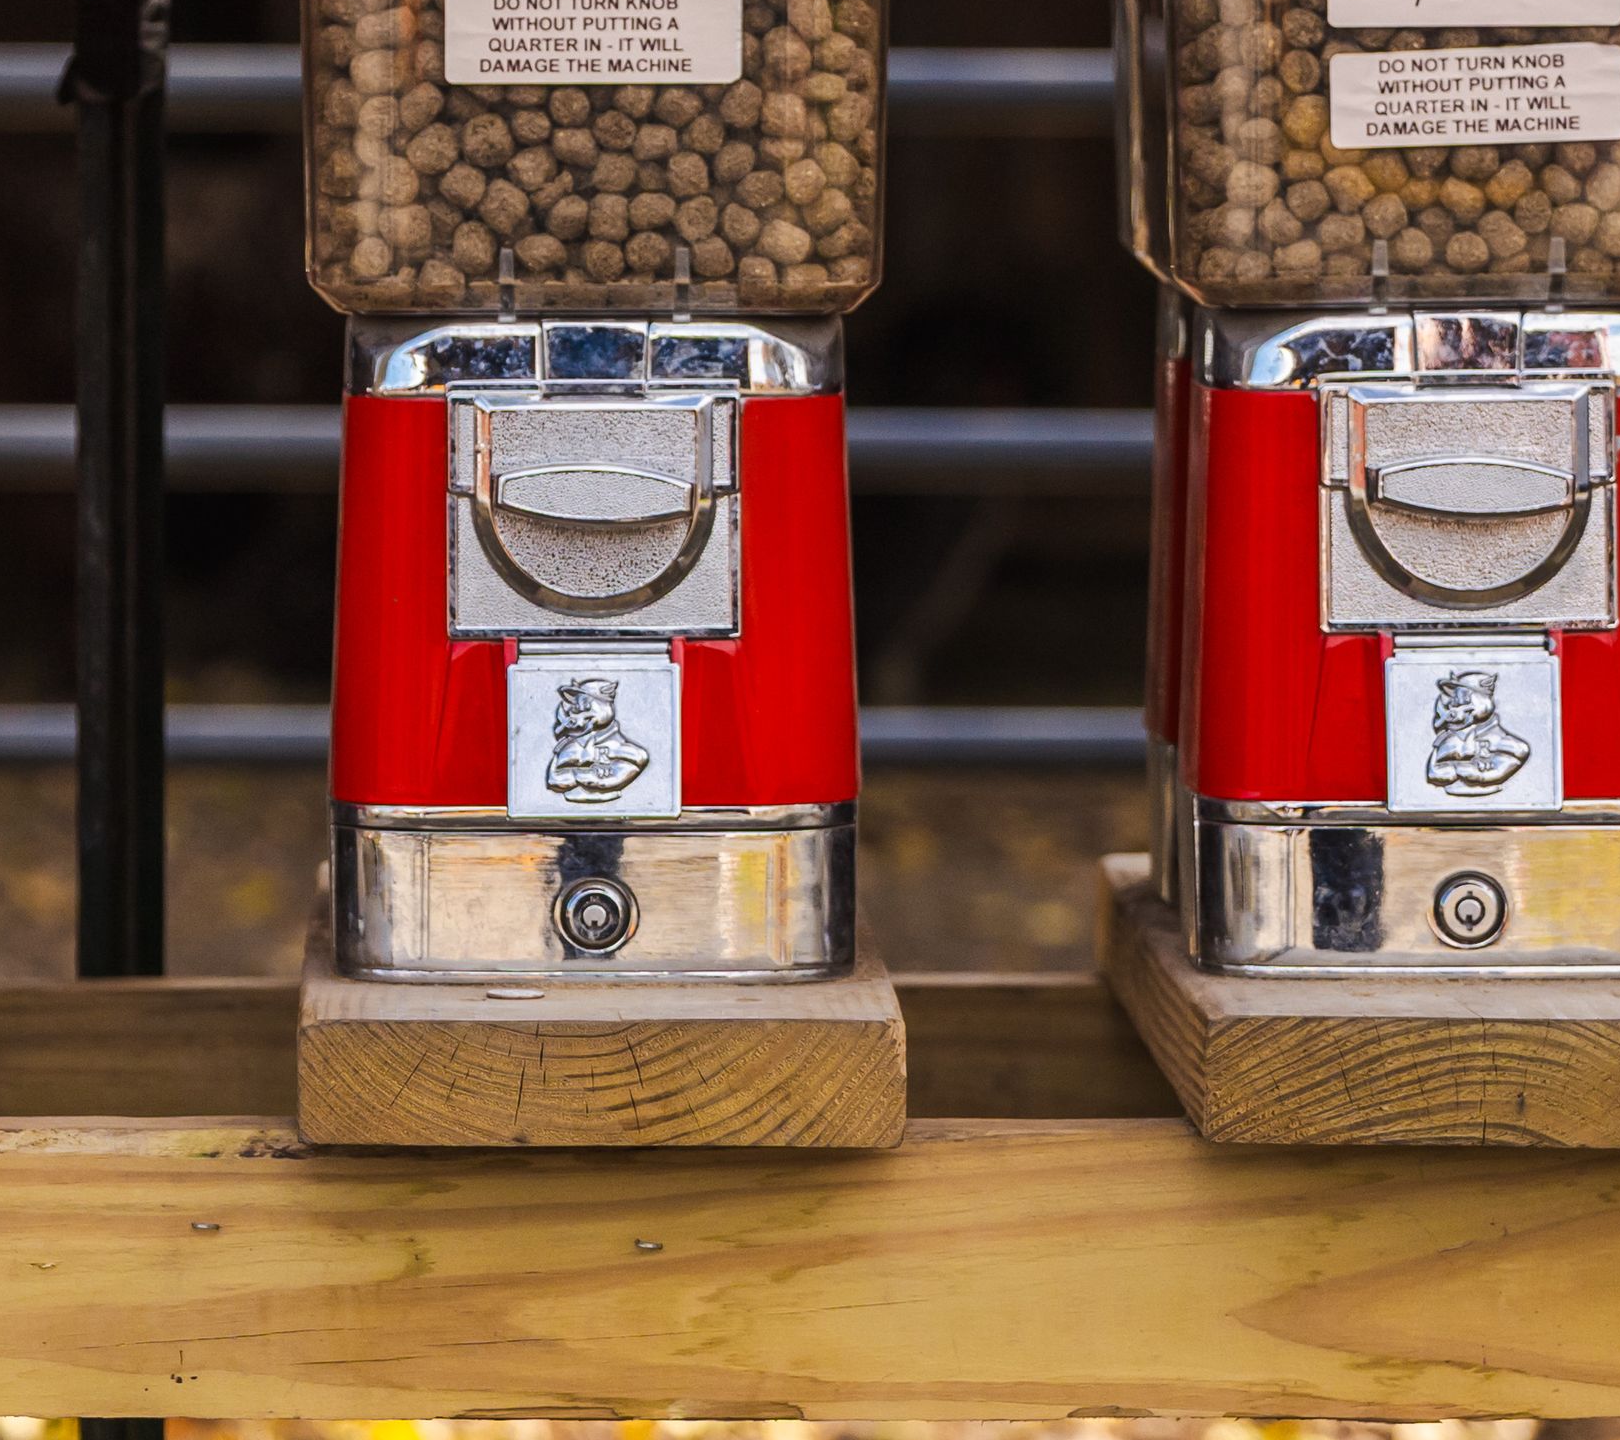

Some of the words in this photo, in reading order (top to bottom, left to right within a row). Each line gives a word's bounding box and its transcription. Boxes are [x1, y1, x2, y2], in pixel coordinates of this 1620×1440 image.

[491, 16, 577, 32] WITHOUT
[582, 16, 663, 32] PUTTING
[666, 16, 680, 31] A
[488, 37, 578, 54] QUARTER
[584, 37, 602, 52] IN
[618, 37, 635, 52] IT
[638, 37, 684, 52] WILL
[479, 58, 560, 73] DAMAGE
[565, 58, 602, 73] THE
[607, 58, 692, 73] MACHINE
[1378, 58, 1406, 74] DO
[1411, 57, 1449, 73] NOT
[1454, 55, 1506, 72] TURN
[1511, 53, 1565, 69] KNOB
[1377, 77, 1463, 95] WITHOUT
[1468, 74, 1549, 92] PUTTING
[1554, 74, 1566, 89] A
[1374, 98, 1465, 117] QUARTER
[1470, 98, 1489, 112] IN
[1505, 96, 1521, 112] IT
[1526, 95, 1571, 111] WILL
[1366, 119, 1447, 137] DAMAGE
[1452, 118, 1489, 134] THE
[1495, 115, 1580, 133] MACHINE
